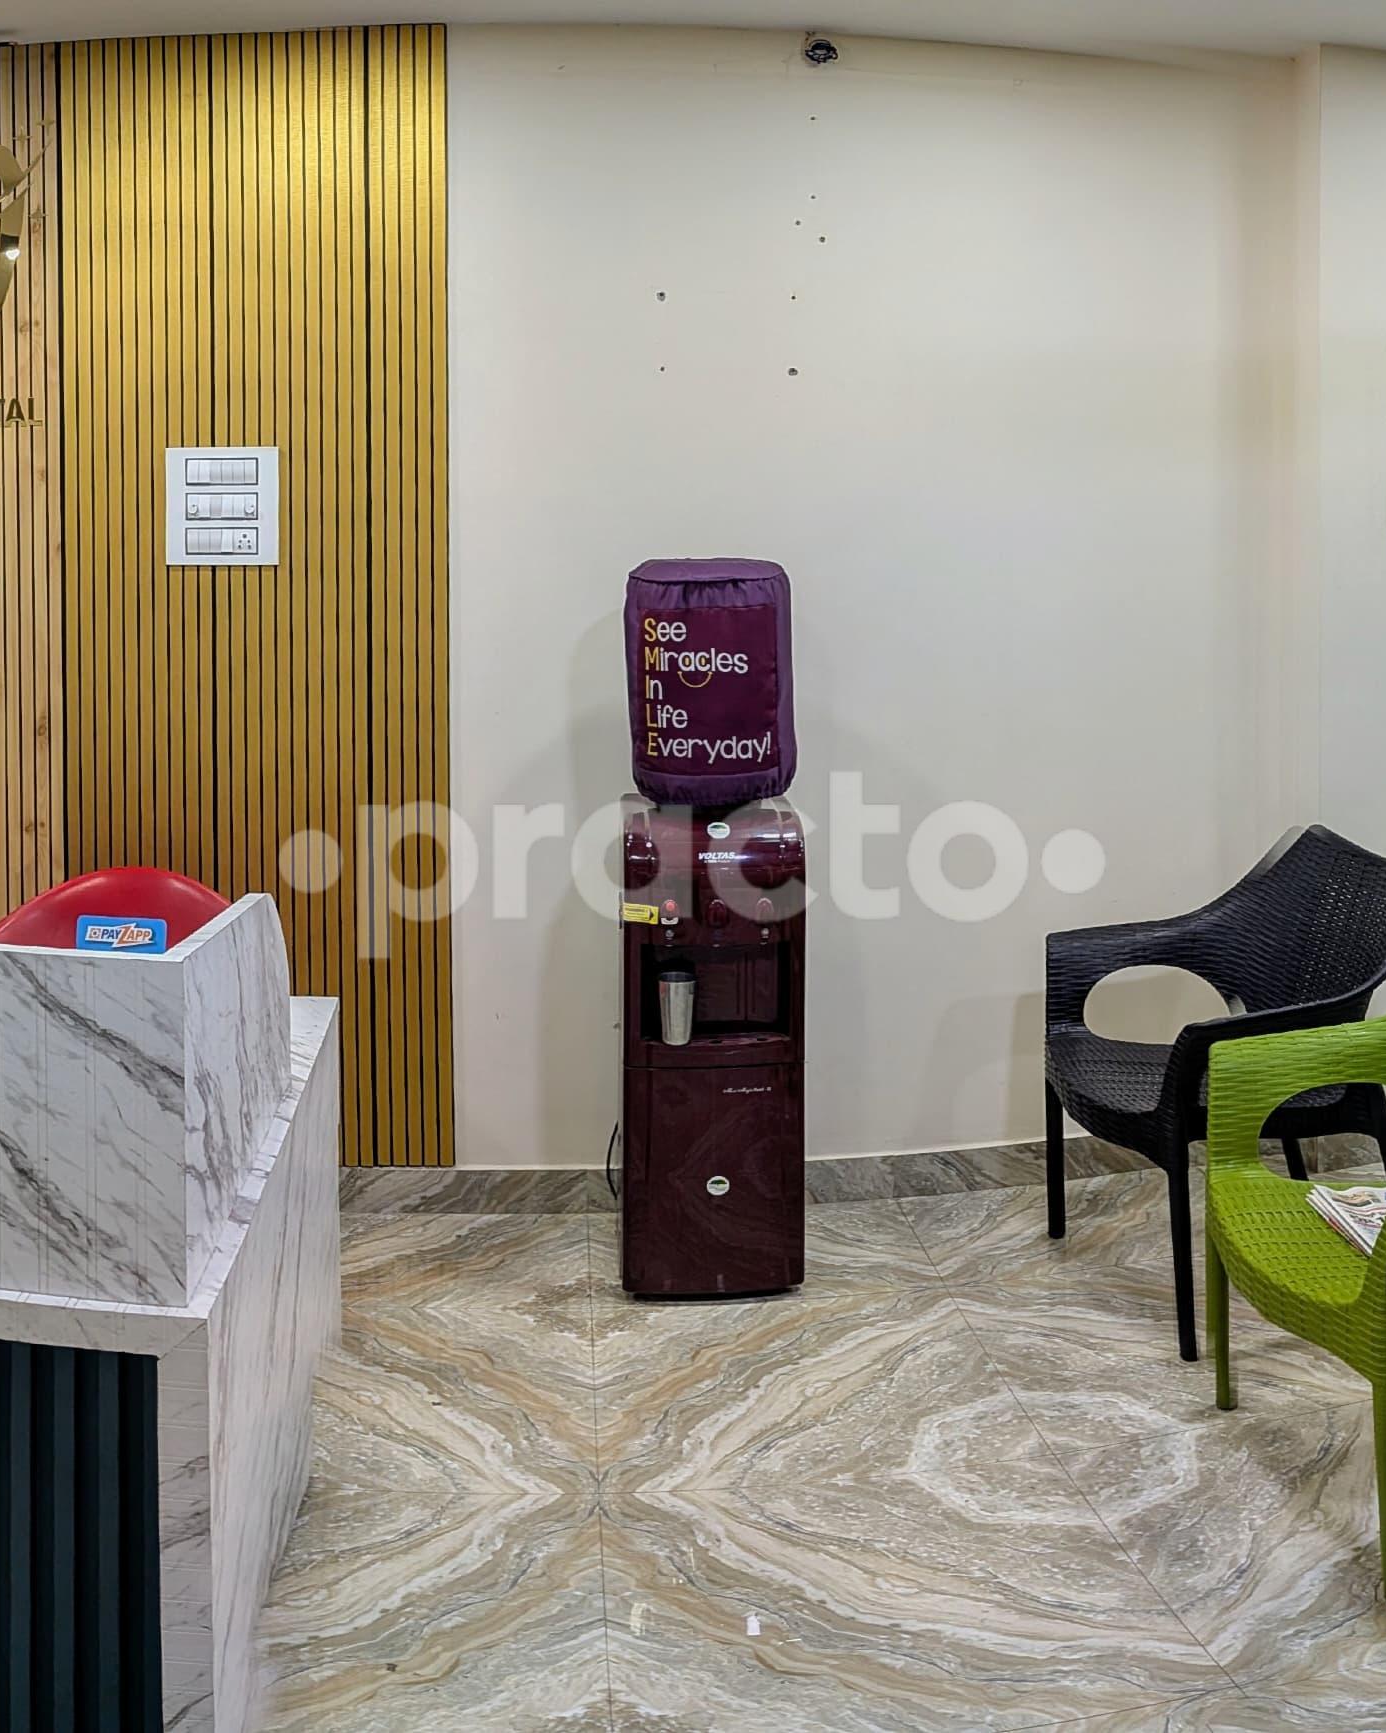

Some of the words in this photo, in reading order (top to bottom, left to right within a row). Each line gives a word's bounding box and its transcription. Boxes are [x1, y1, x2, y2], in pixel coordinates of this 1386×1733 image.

[644, 617, 687, 642] See
[644, 646, 749, 674] Miracles
[645, 675, 663, 700] In
[646, 703, 689, 728] Life
[647, 731, 771, 764] Everyday!
[698, 851, 735, 860] VOLTAS
